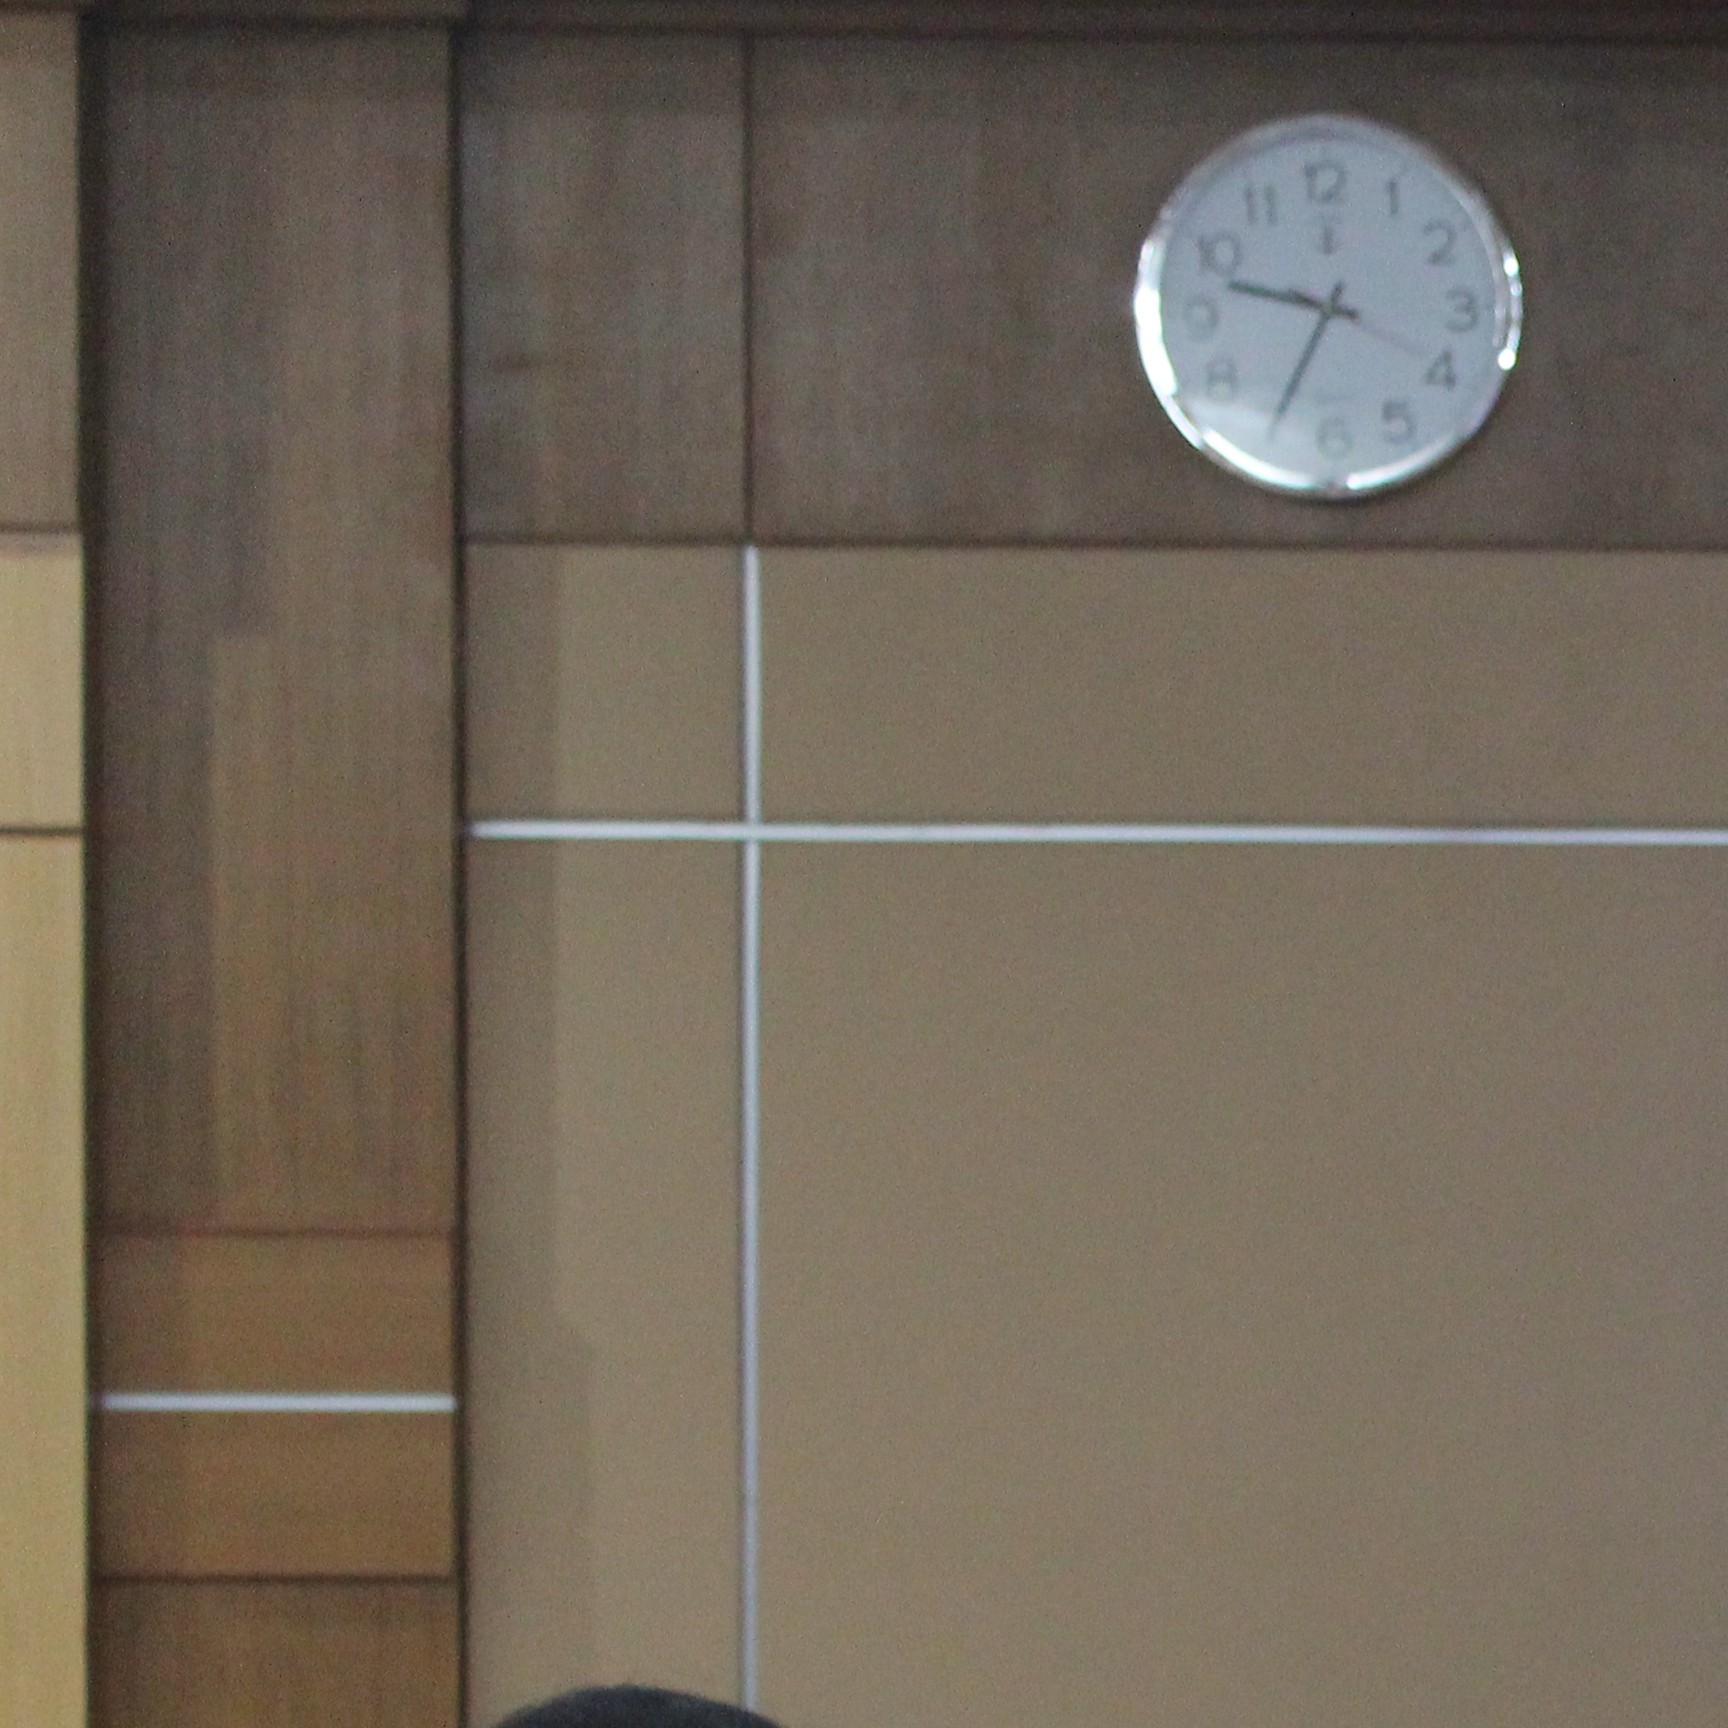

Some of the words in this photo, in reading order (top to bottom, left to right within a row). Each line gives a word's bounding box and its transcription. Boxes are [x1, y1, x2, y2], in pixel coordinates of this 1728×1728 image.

[1245, 182, 1278, 226] 11
[1386, 179, 1399, 215] 1
[1422, 220, 1457, 265] 2
[1445, 287, 1479, 333] 3
[1425, 351, 1457, 391] 4
[1317, 417, 1351, 459] 6
[1382, 400, 1415, 443] 5
